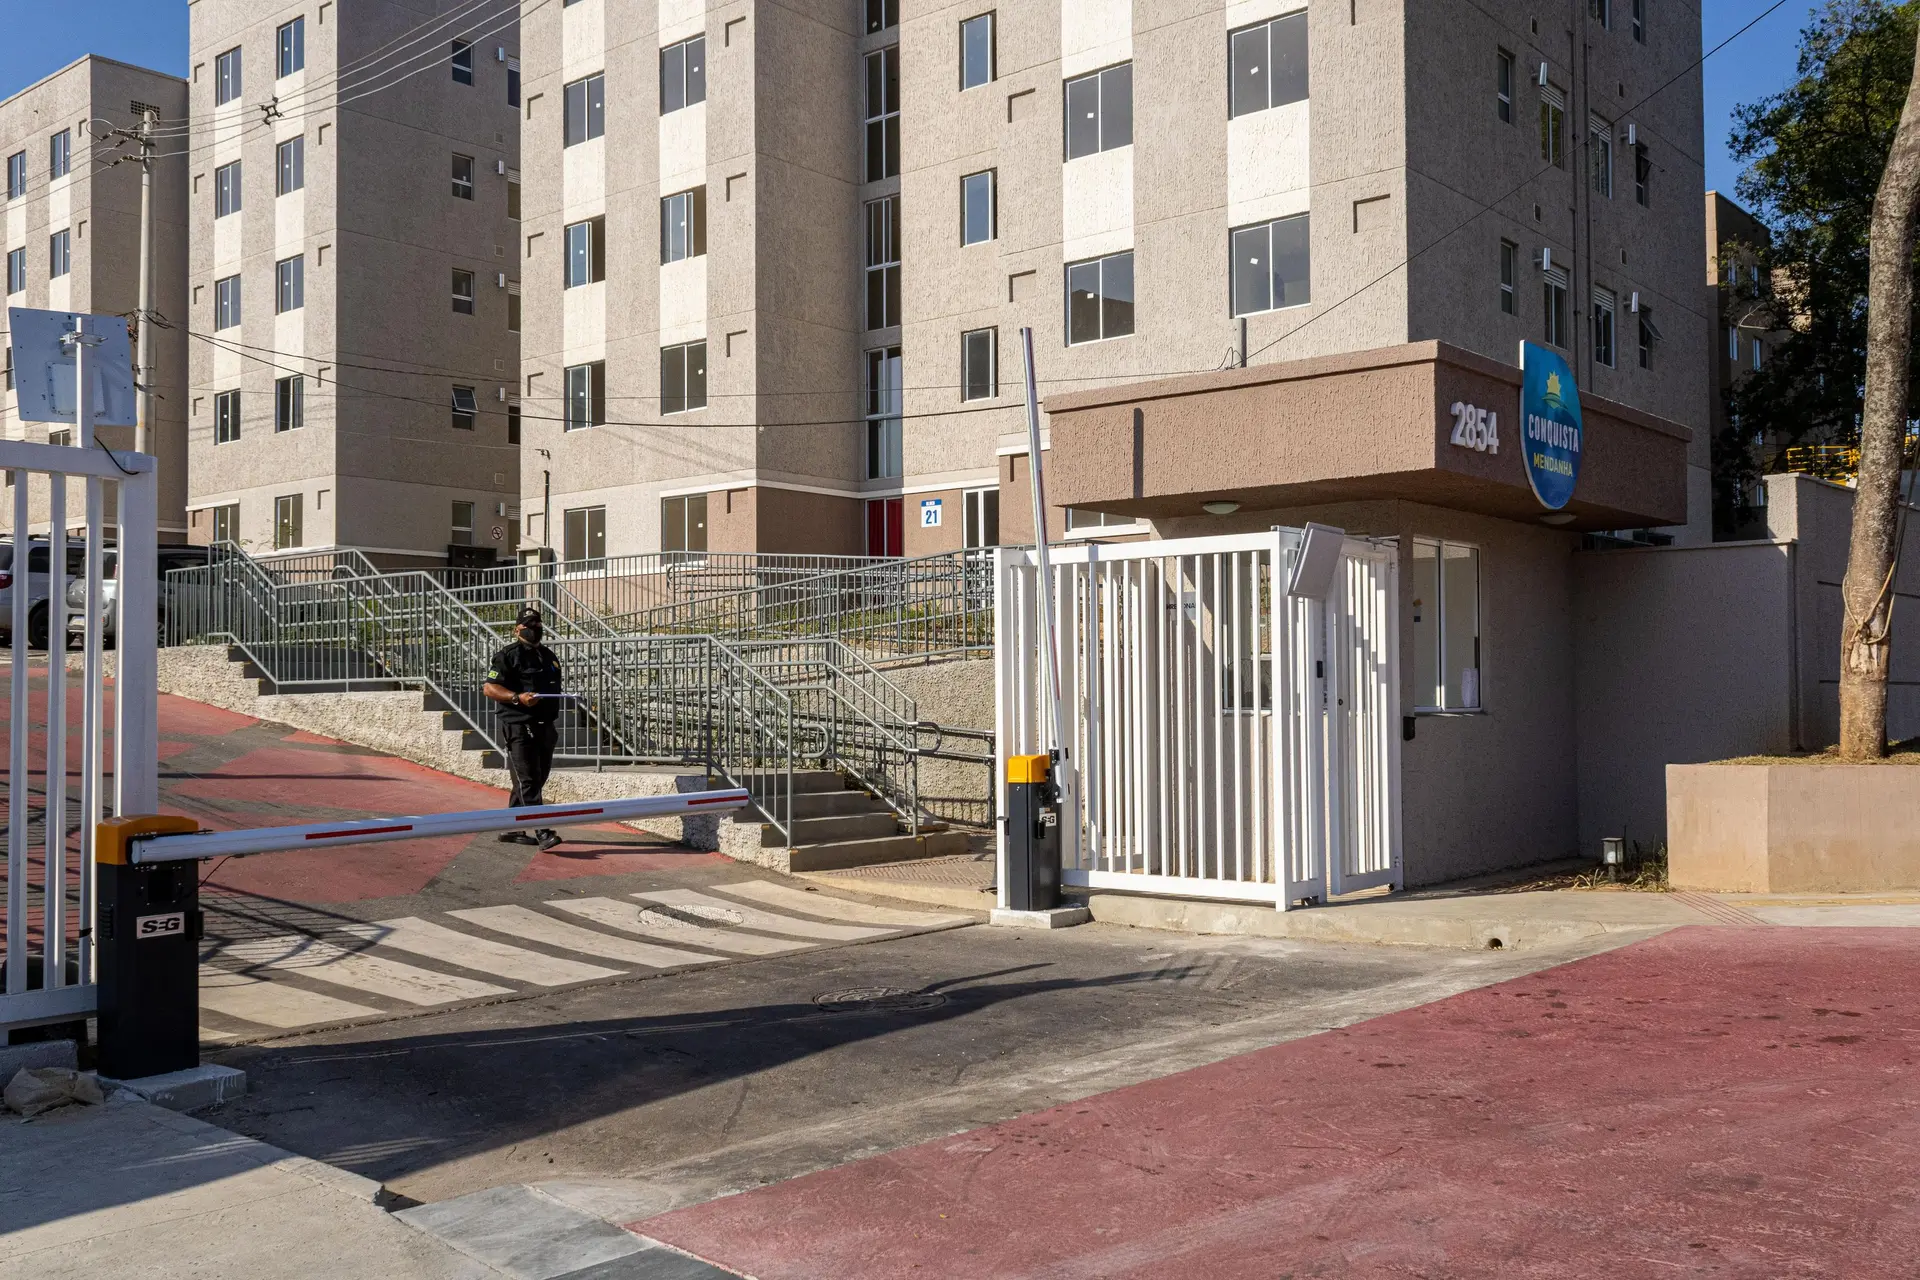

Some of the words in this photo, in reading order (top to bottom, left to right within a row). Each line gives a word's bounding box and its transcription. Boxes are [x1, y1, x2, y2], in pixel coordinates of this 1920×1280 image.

[1450, 401, 1499, 455] 2854
[1528, 413, 1579, 453] CONQUISTA
[1533, 452, 1573, 477] MENDANHA
[925, 509, 938, 525] 21
[141, 917, 181, 934] SEG
